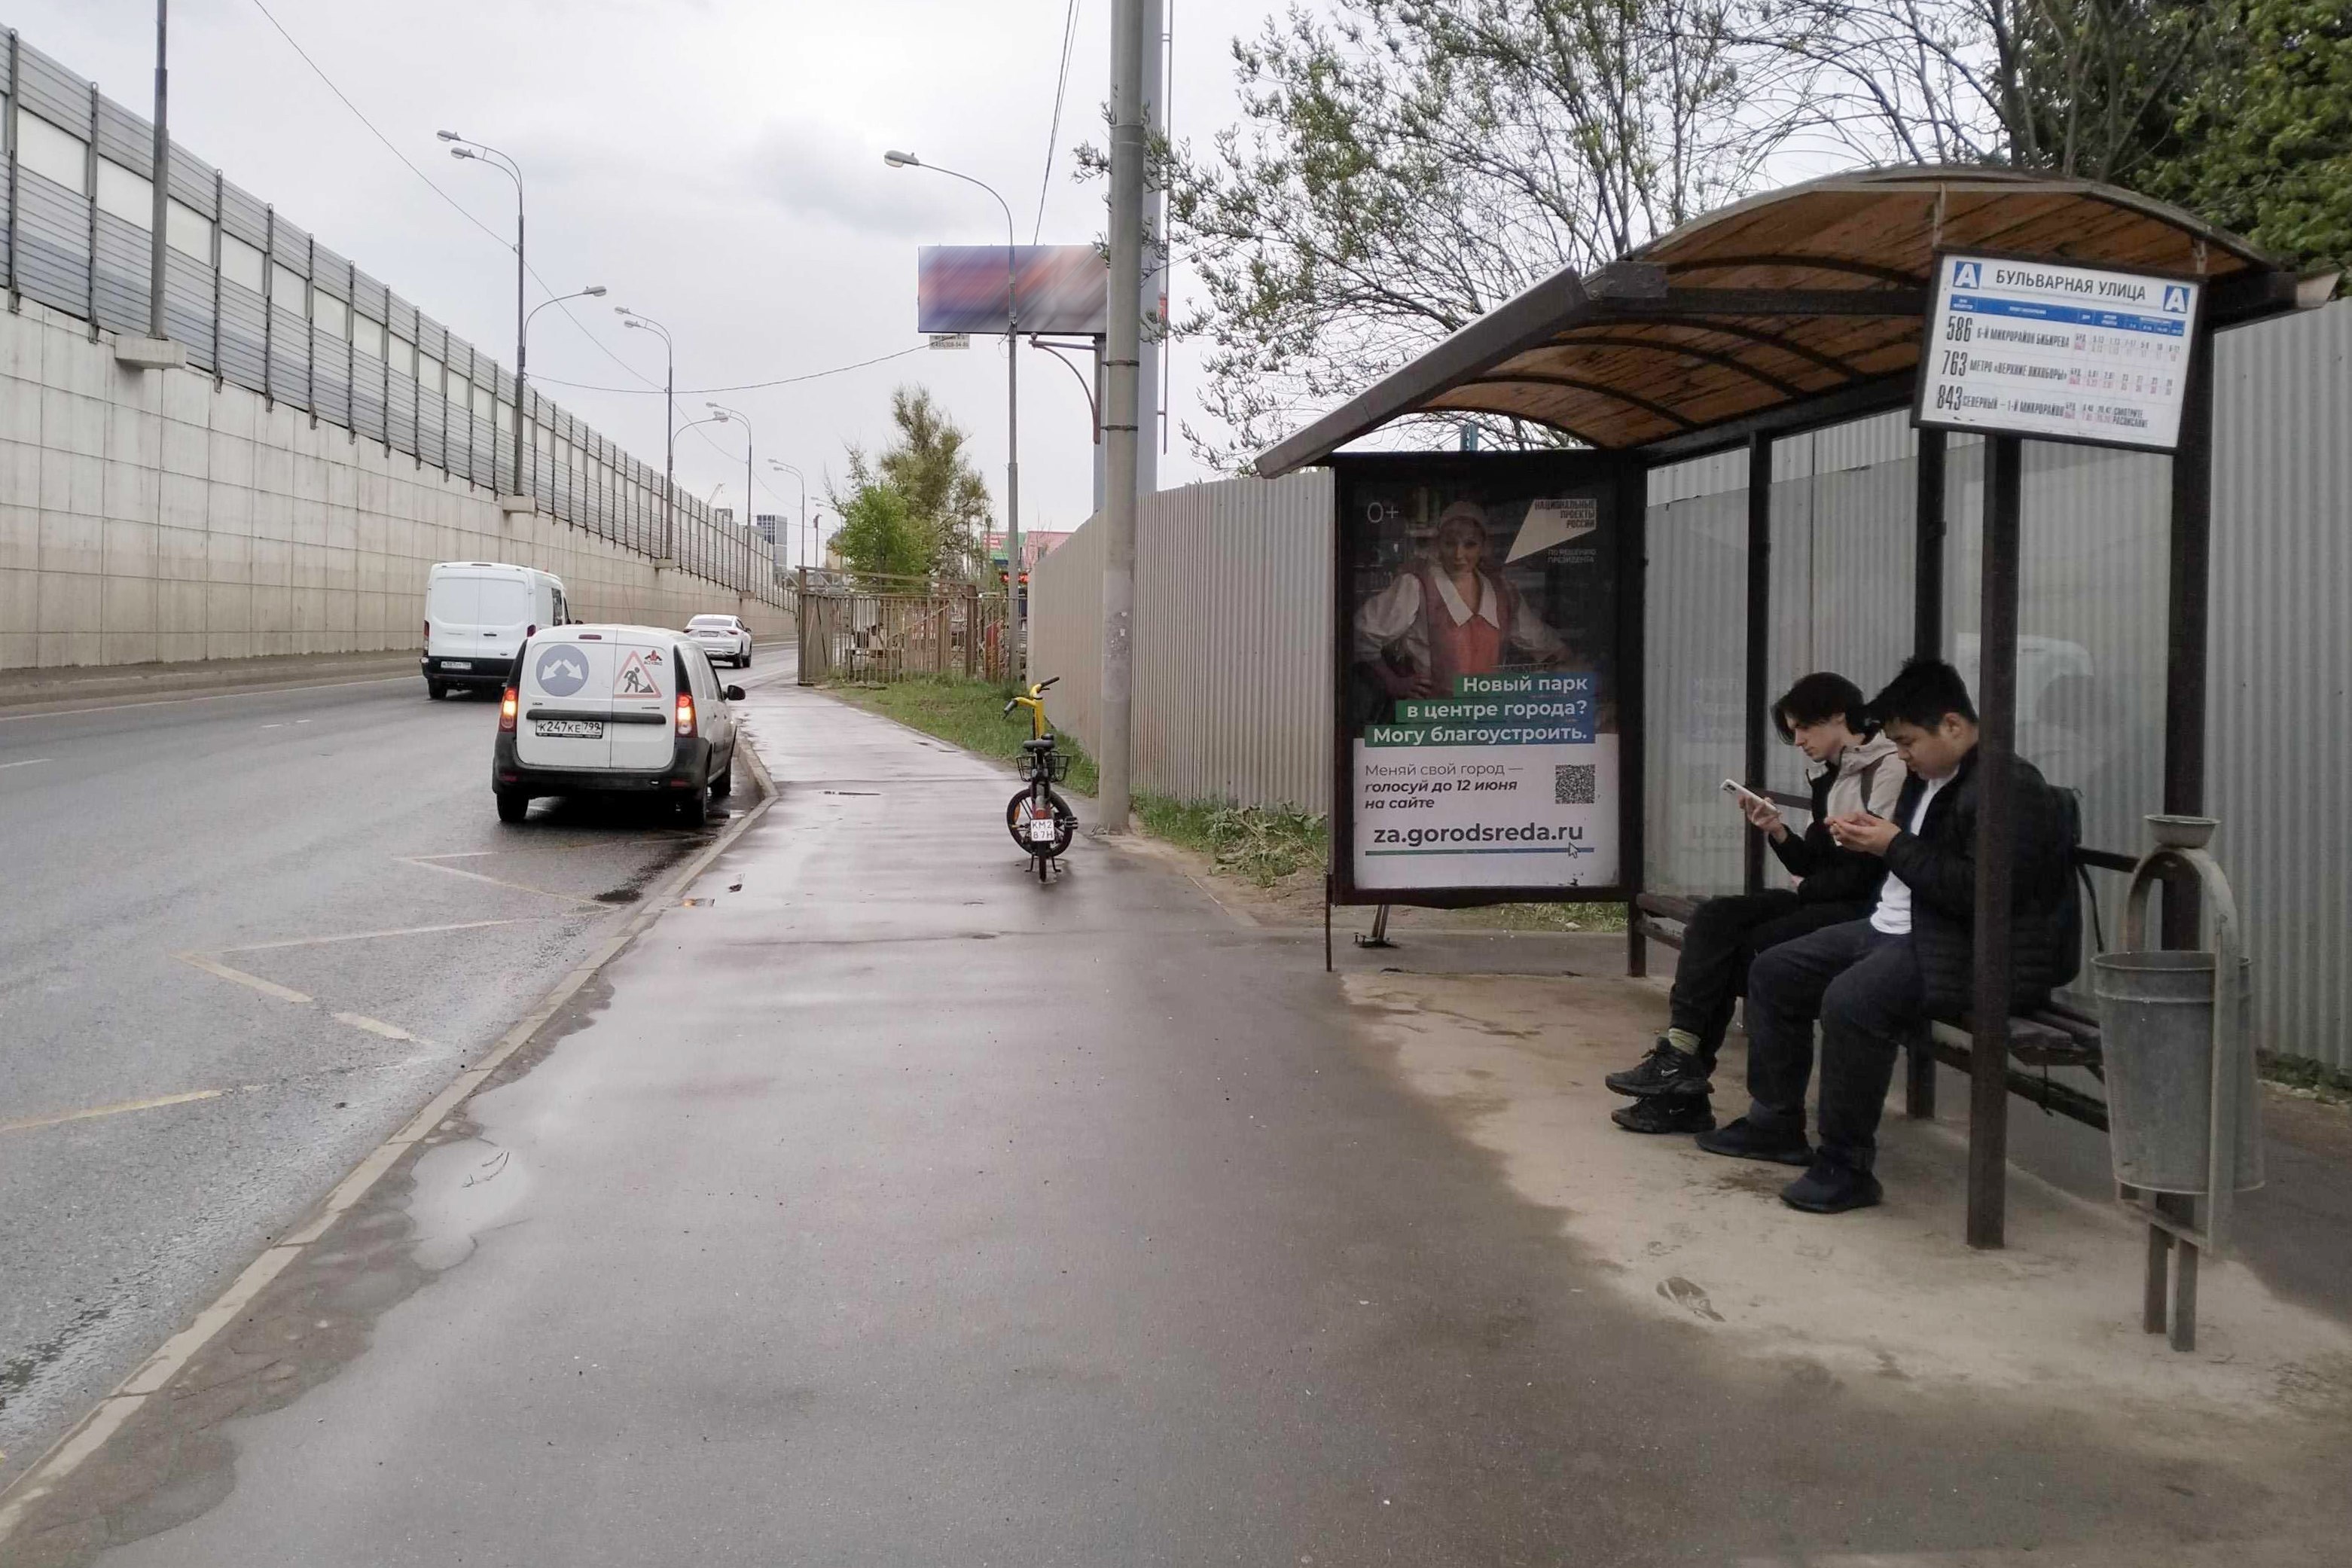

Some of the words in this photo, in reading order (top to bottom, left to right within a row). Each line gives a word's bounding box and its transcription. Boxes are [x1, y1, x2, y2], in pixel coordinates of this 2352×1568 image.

[1996, 269, 2094, 294] БУЛЬВАРНАЯ
[2098, 280, 2146, 301] УЛИЦА
[1946, 316, 1972, 342] 586
[1942, 349, 1968, 377] 763
[1969, 359, 1993, 373] МЕТРО
[1937, 384, 1963, 410] 843
[1962, 395, 1997, 410] СЕВЕРНЫЙ
[1366, 502, 1400, 523] 0+
[1560, 509, 1595, 520] ПРОЕКТЫ
[1566, 519, 1595, 529] РОССИИ
[1463, 675, 1532, 694] Новый
[1538, 677, 1588, 695] парк
[1407, 706, 1418, 718] в
[1424, 704, 1499, 721] центре
[1505, 700, 1588, 718] города?
[539, 721, 581, 734] К247КЕ
[1374, 728, 1426, 746] Могу
[1431, 726, 1587, 745] благоустроить.
[1365, 763, 1417, 776] Меняй
[1420, 762, 1457, 776] свой
[1460, 764, 1506, 779] город
[1365, 779, 1429, 796] голосуй
[1432, 781, 1453, 794] до
[1457, 779, 1470, 792] 12
[1474, 779, 1518, 792] июня
[1365, 798, 1386, 810] на
[1389, 795, 1435, 810] сайте
[1374, 822, 1584, 847] za.gorodsreda.ru
